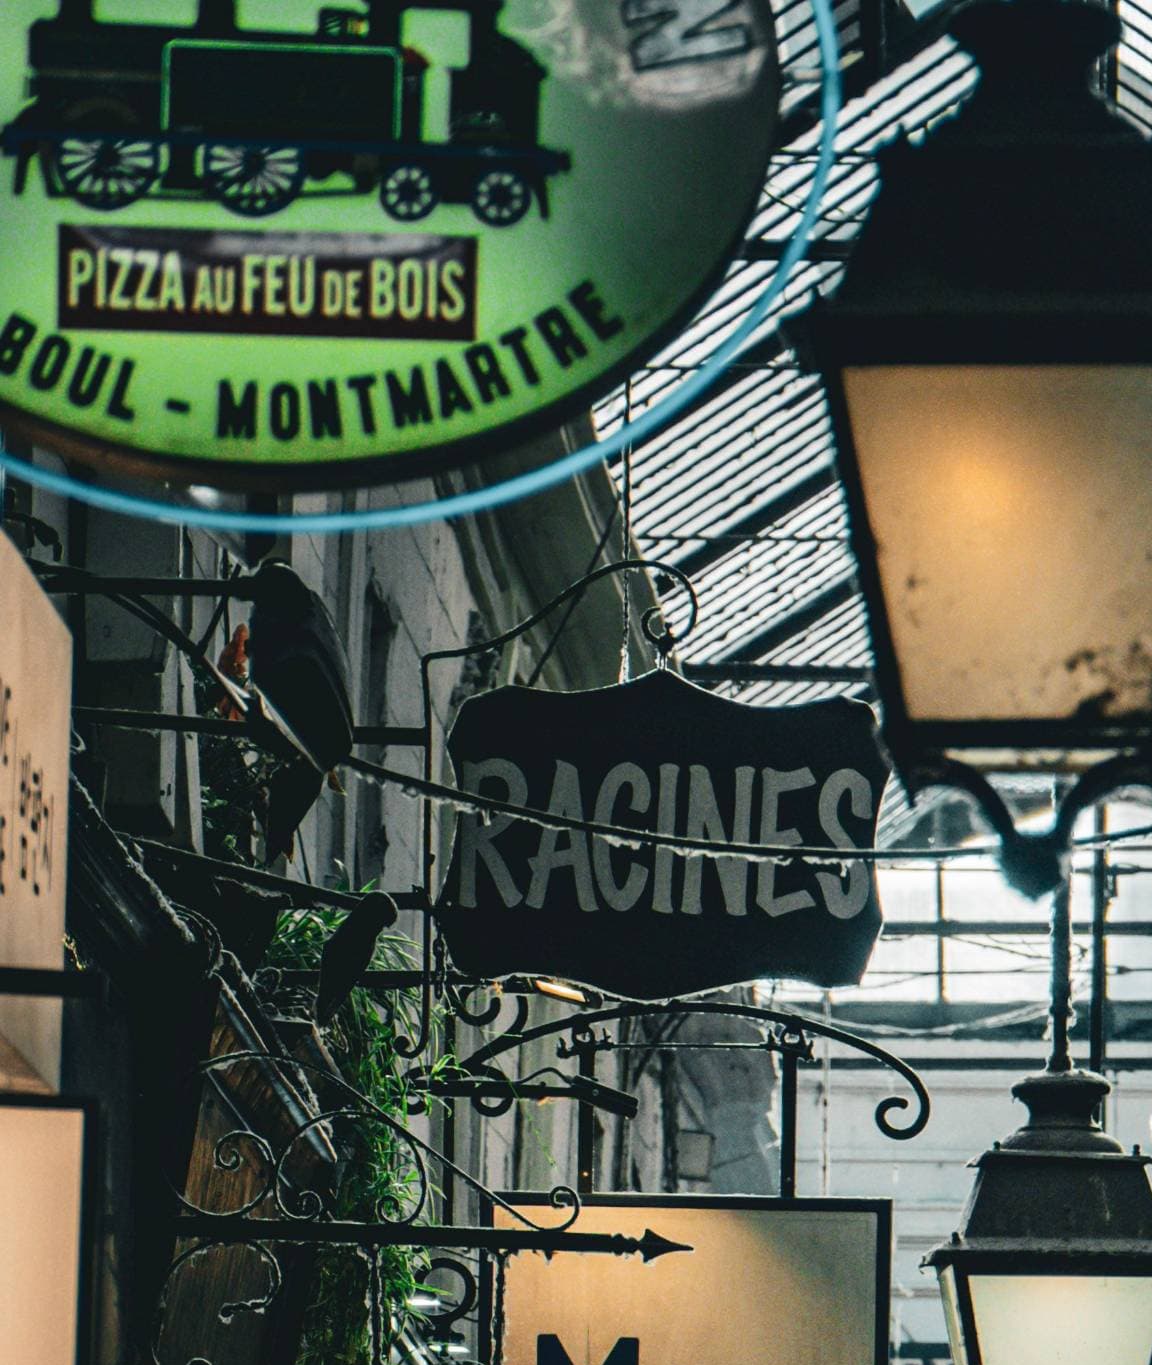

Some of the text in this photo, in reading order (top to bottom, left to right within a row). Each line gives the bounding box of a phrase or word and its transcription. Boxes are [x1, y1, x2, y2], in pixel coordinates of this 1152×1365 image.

[0, 311, 136, 423] BOUL
[214, 277, 626, 442] MONTMARTRE
[67, 248, 467, 323] PIZZA AU FEU DE BOIS
[458, 757, 874, 920] RACINES
